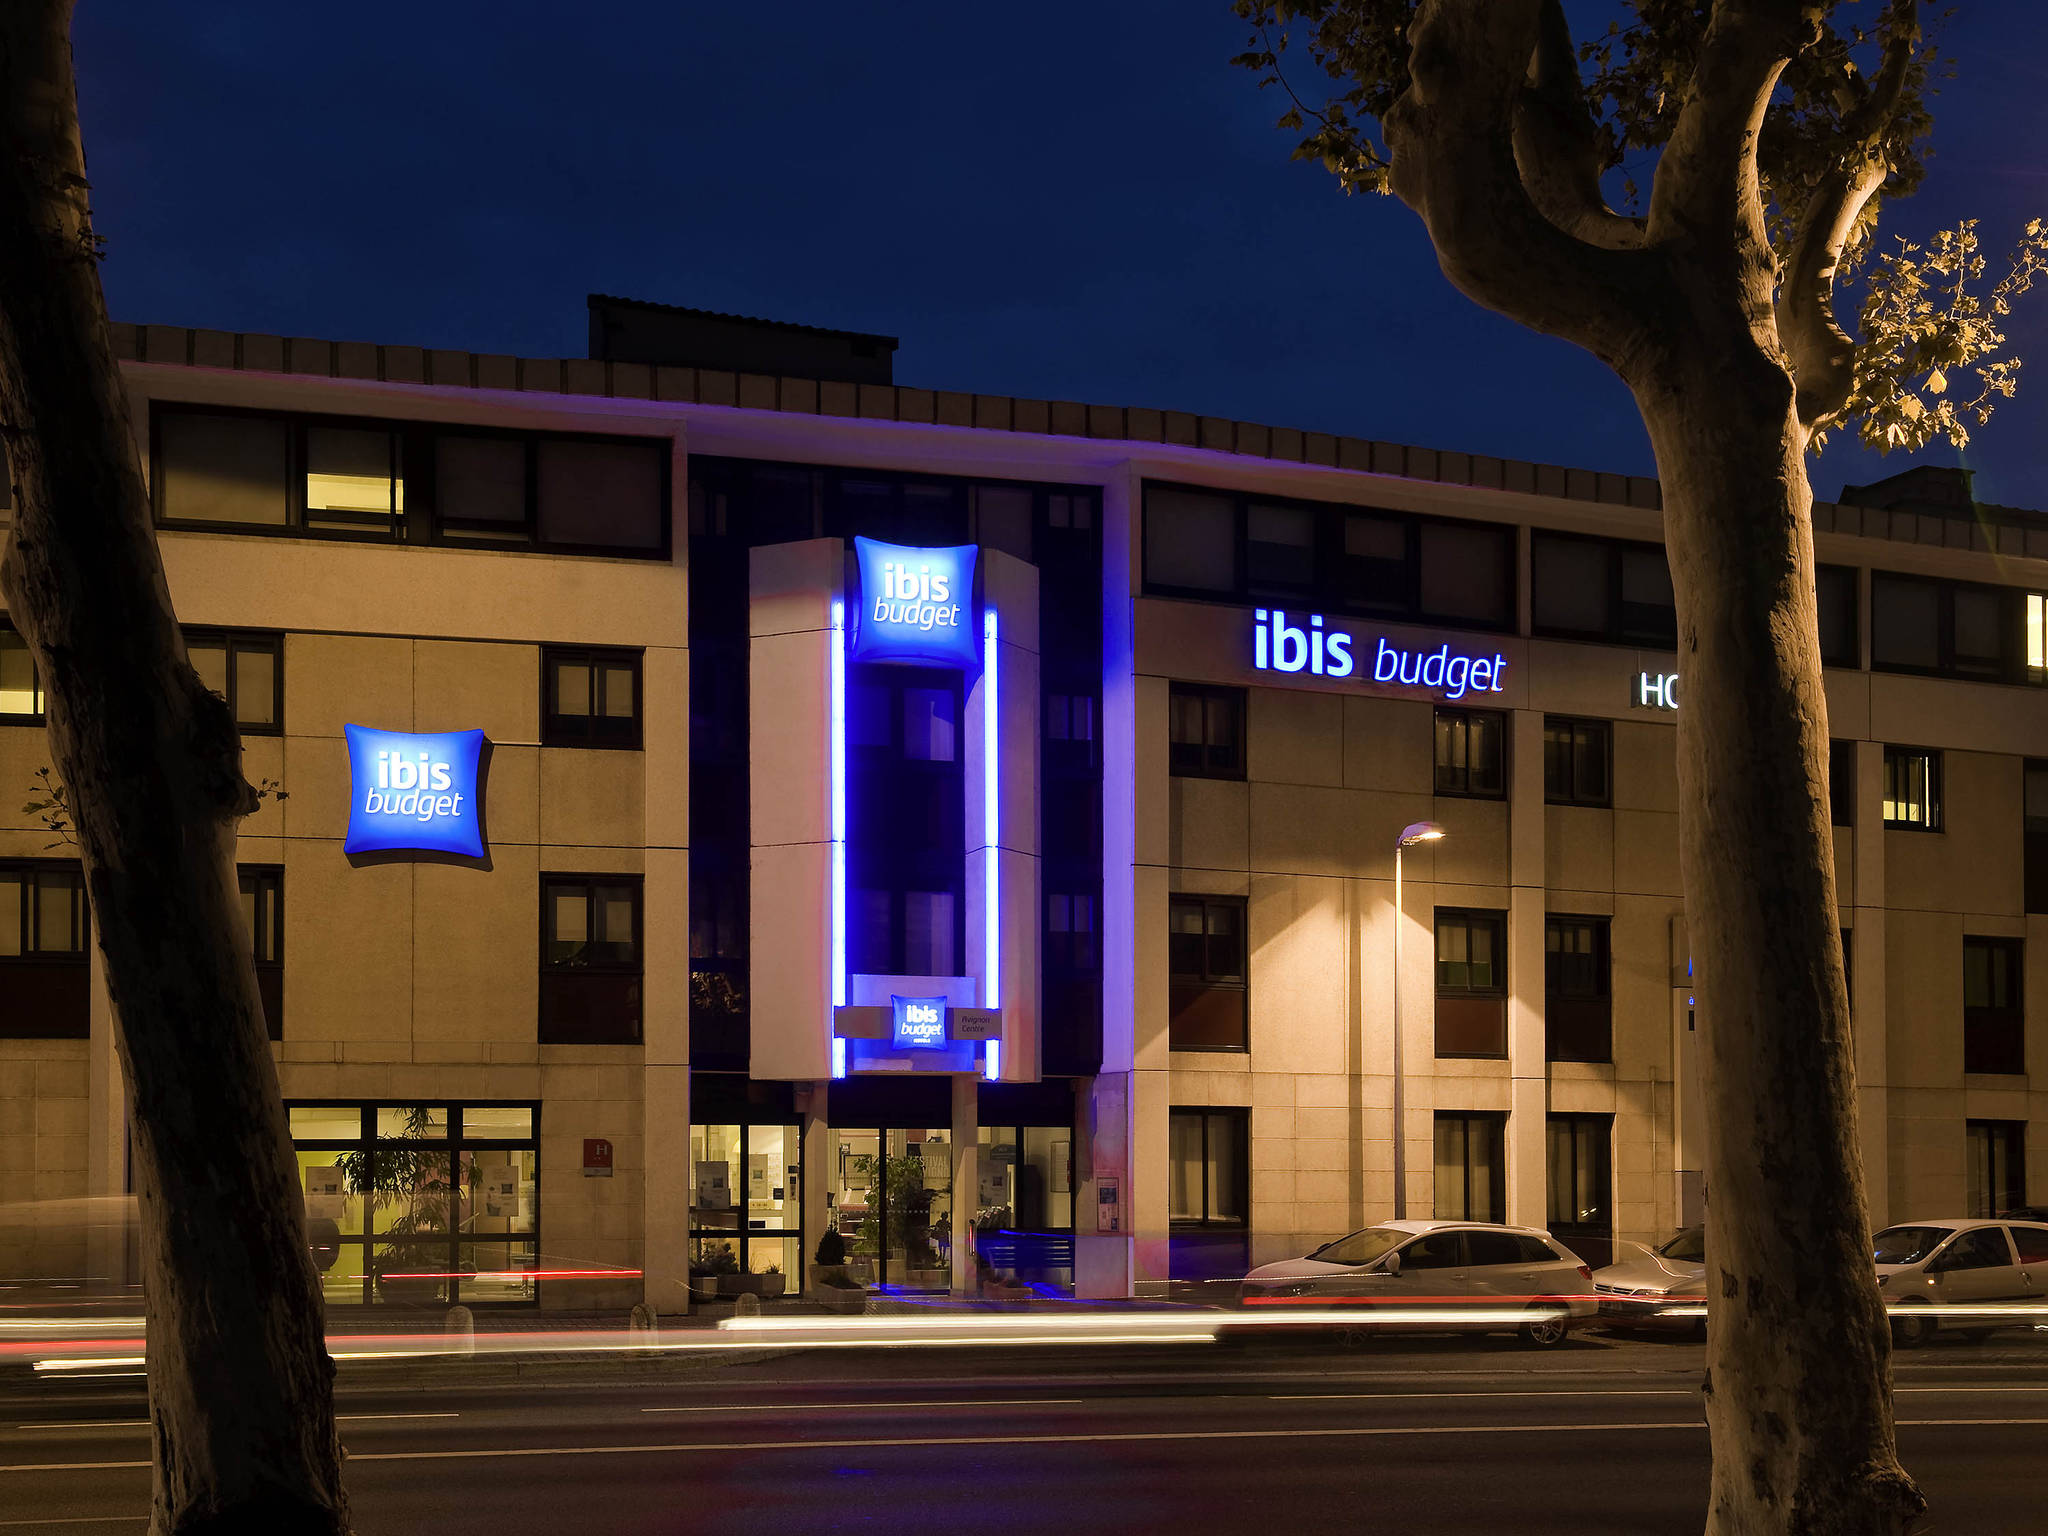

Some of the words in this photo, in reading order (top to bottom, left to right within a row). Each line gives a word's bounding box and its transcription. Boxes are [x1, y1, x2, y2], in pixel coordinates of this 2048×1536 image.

[884, 562, 950, 603] ibis
[873, 596, 961, 631] budget
[1255, 608, 1354, 677] ibis
[1374, 637, 1507, 699] budget
[378, 751, 452, 791] ibis
[365, 787, 464, 822] budget
[900, 1022, 942, 1038] budget
[906, 1004, 938, 1023] ibis
[596, 1144, 608, 1156] H
